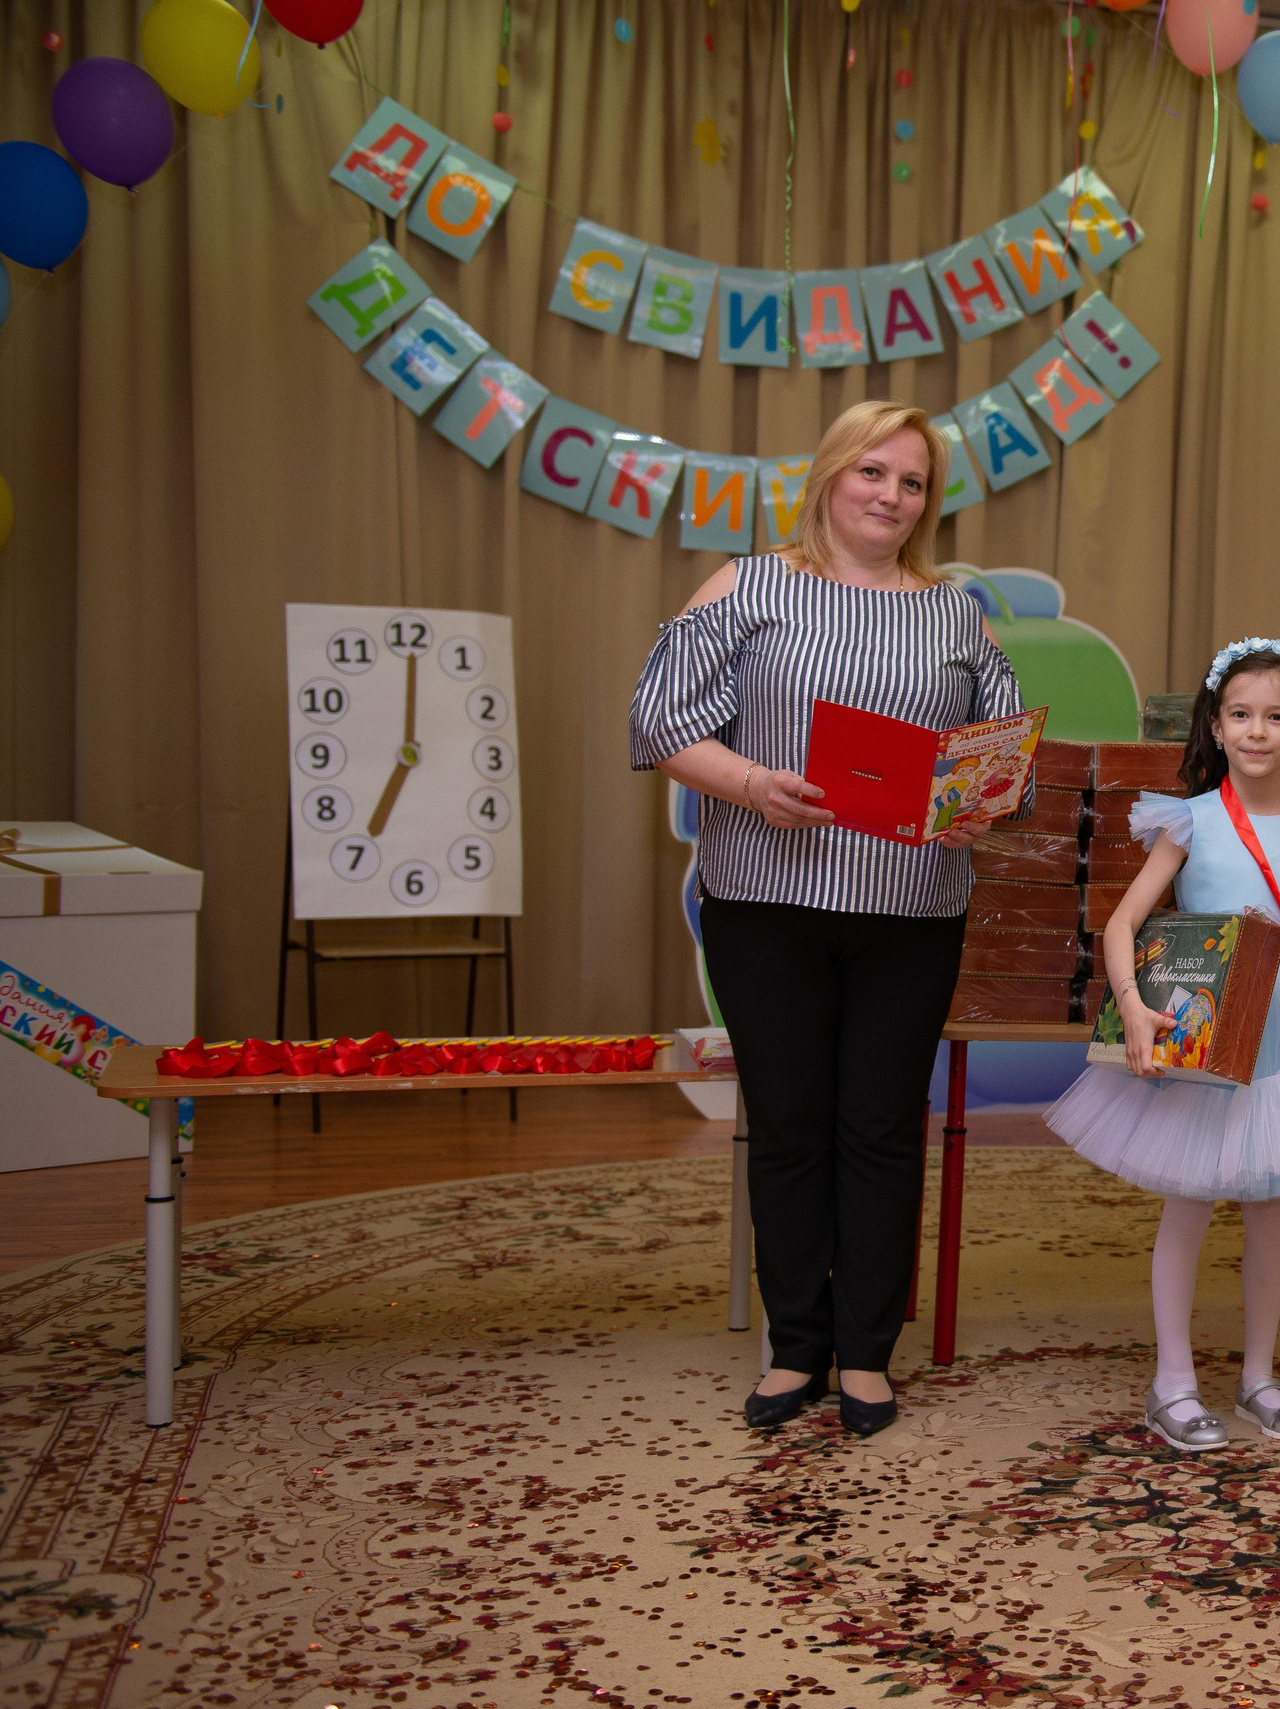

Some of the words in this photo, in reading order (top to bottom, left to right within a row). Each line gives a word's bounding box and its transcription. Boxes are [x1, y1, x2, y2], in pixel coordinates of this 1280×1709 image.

[343, 122, 492, 237] ДО
[319, 265, 811, 538] ДЕТСКИЙ
[944, 318, 1132, 498] АД!
[389, 622, 428, 649] 12
[332, 637, 373, 665] 11
[454, 645, 472, 671] 1
[303, 687, 344, 714] 10
[480, 694, 496, 721] 2
[958, 718, 1024, 743] ДИПЛОМ
[310, 743, 330, 770] 9
[486, 745, 503, 771] 3
[947, 741, 999, 759] ДЕТСКОГО
[1002, 732, 1029, 744] САДА
[315, 796, 337, 822] 8
[478, 796, 498, 822] 4
[344, 844, 366, 871] 7
[462, 845, 482, 872] 5
[404, 869, 425, 896] 6
[1147, 963, 1217, 987] Первоклассника
[1174, 957, 1205, 969] НАБОР
